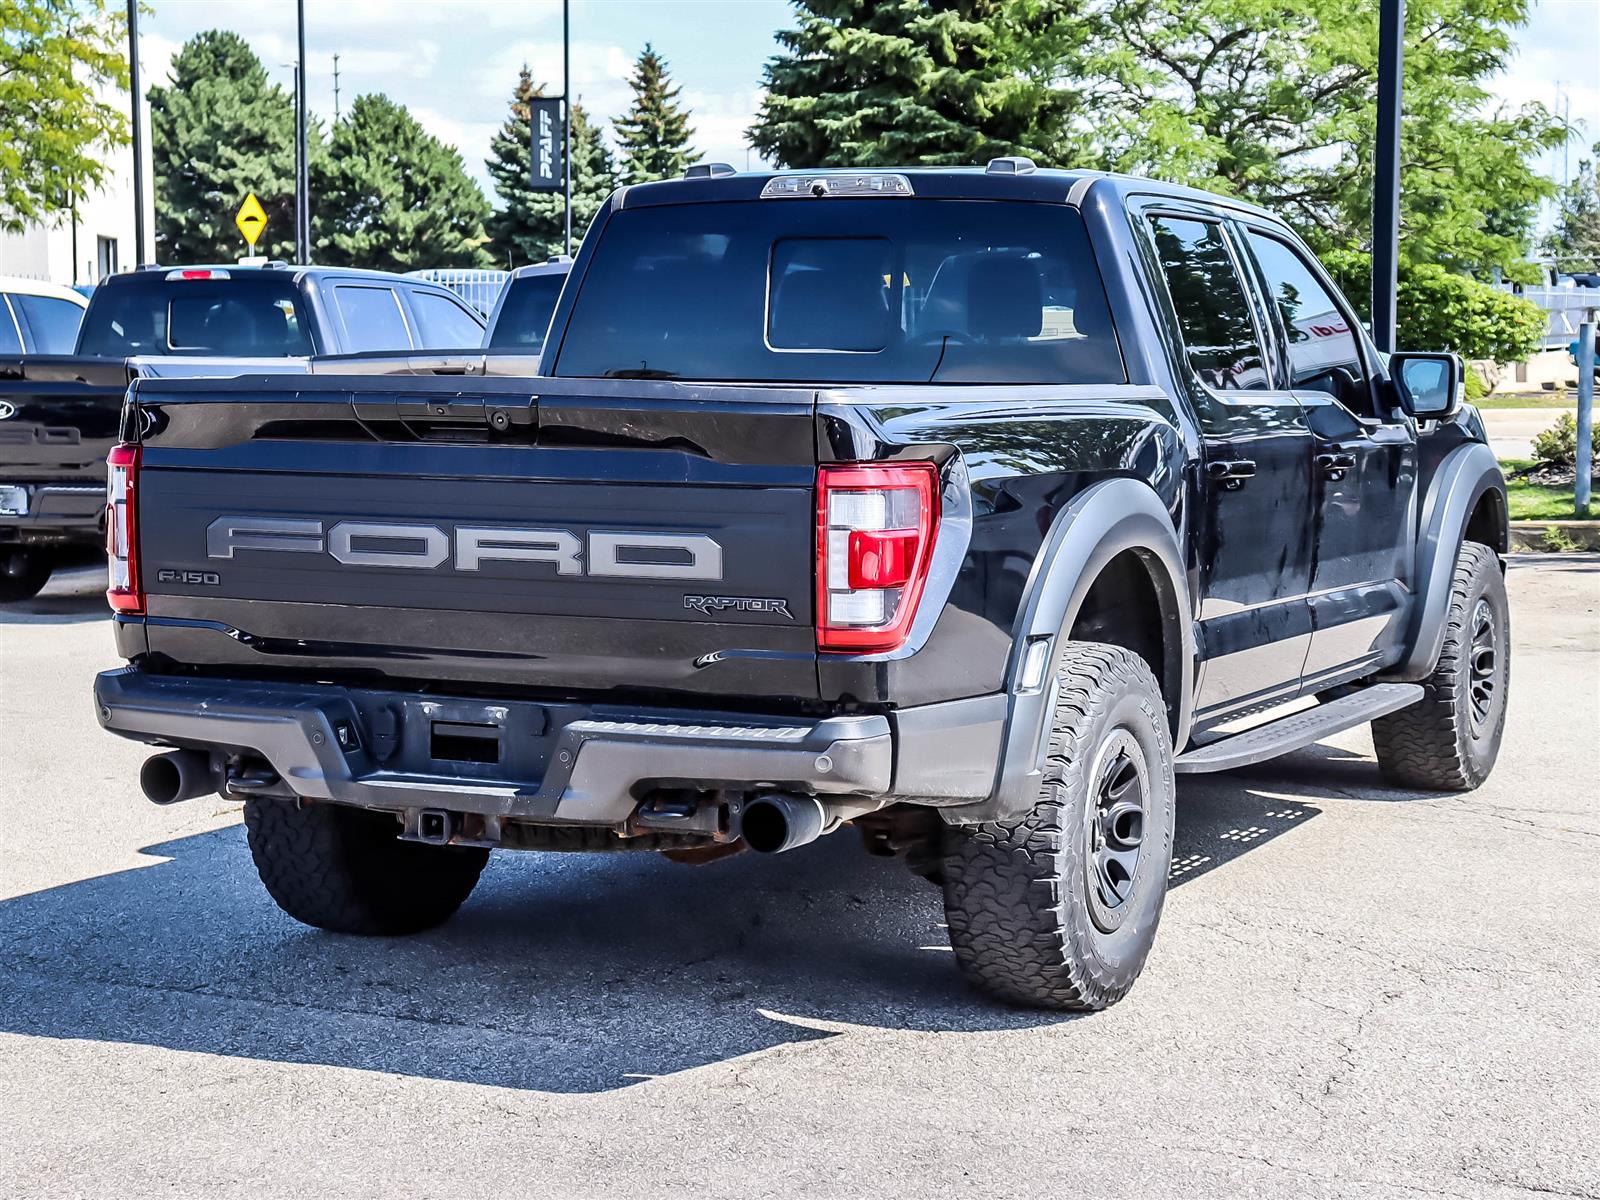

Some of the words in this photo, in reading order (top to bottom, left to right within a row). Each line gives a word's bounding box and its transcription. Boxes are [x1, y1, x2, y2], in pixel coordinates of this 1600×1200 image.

[539, 109, 553, 179] PFAFF
[206, 515, 723, 580] FORD
[157, 570, 220, 585] F-150
[683, 594, 795, 620] RAPTOR
